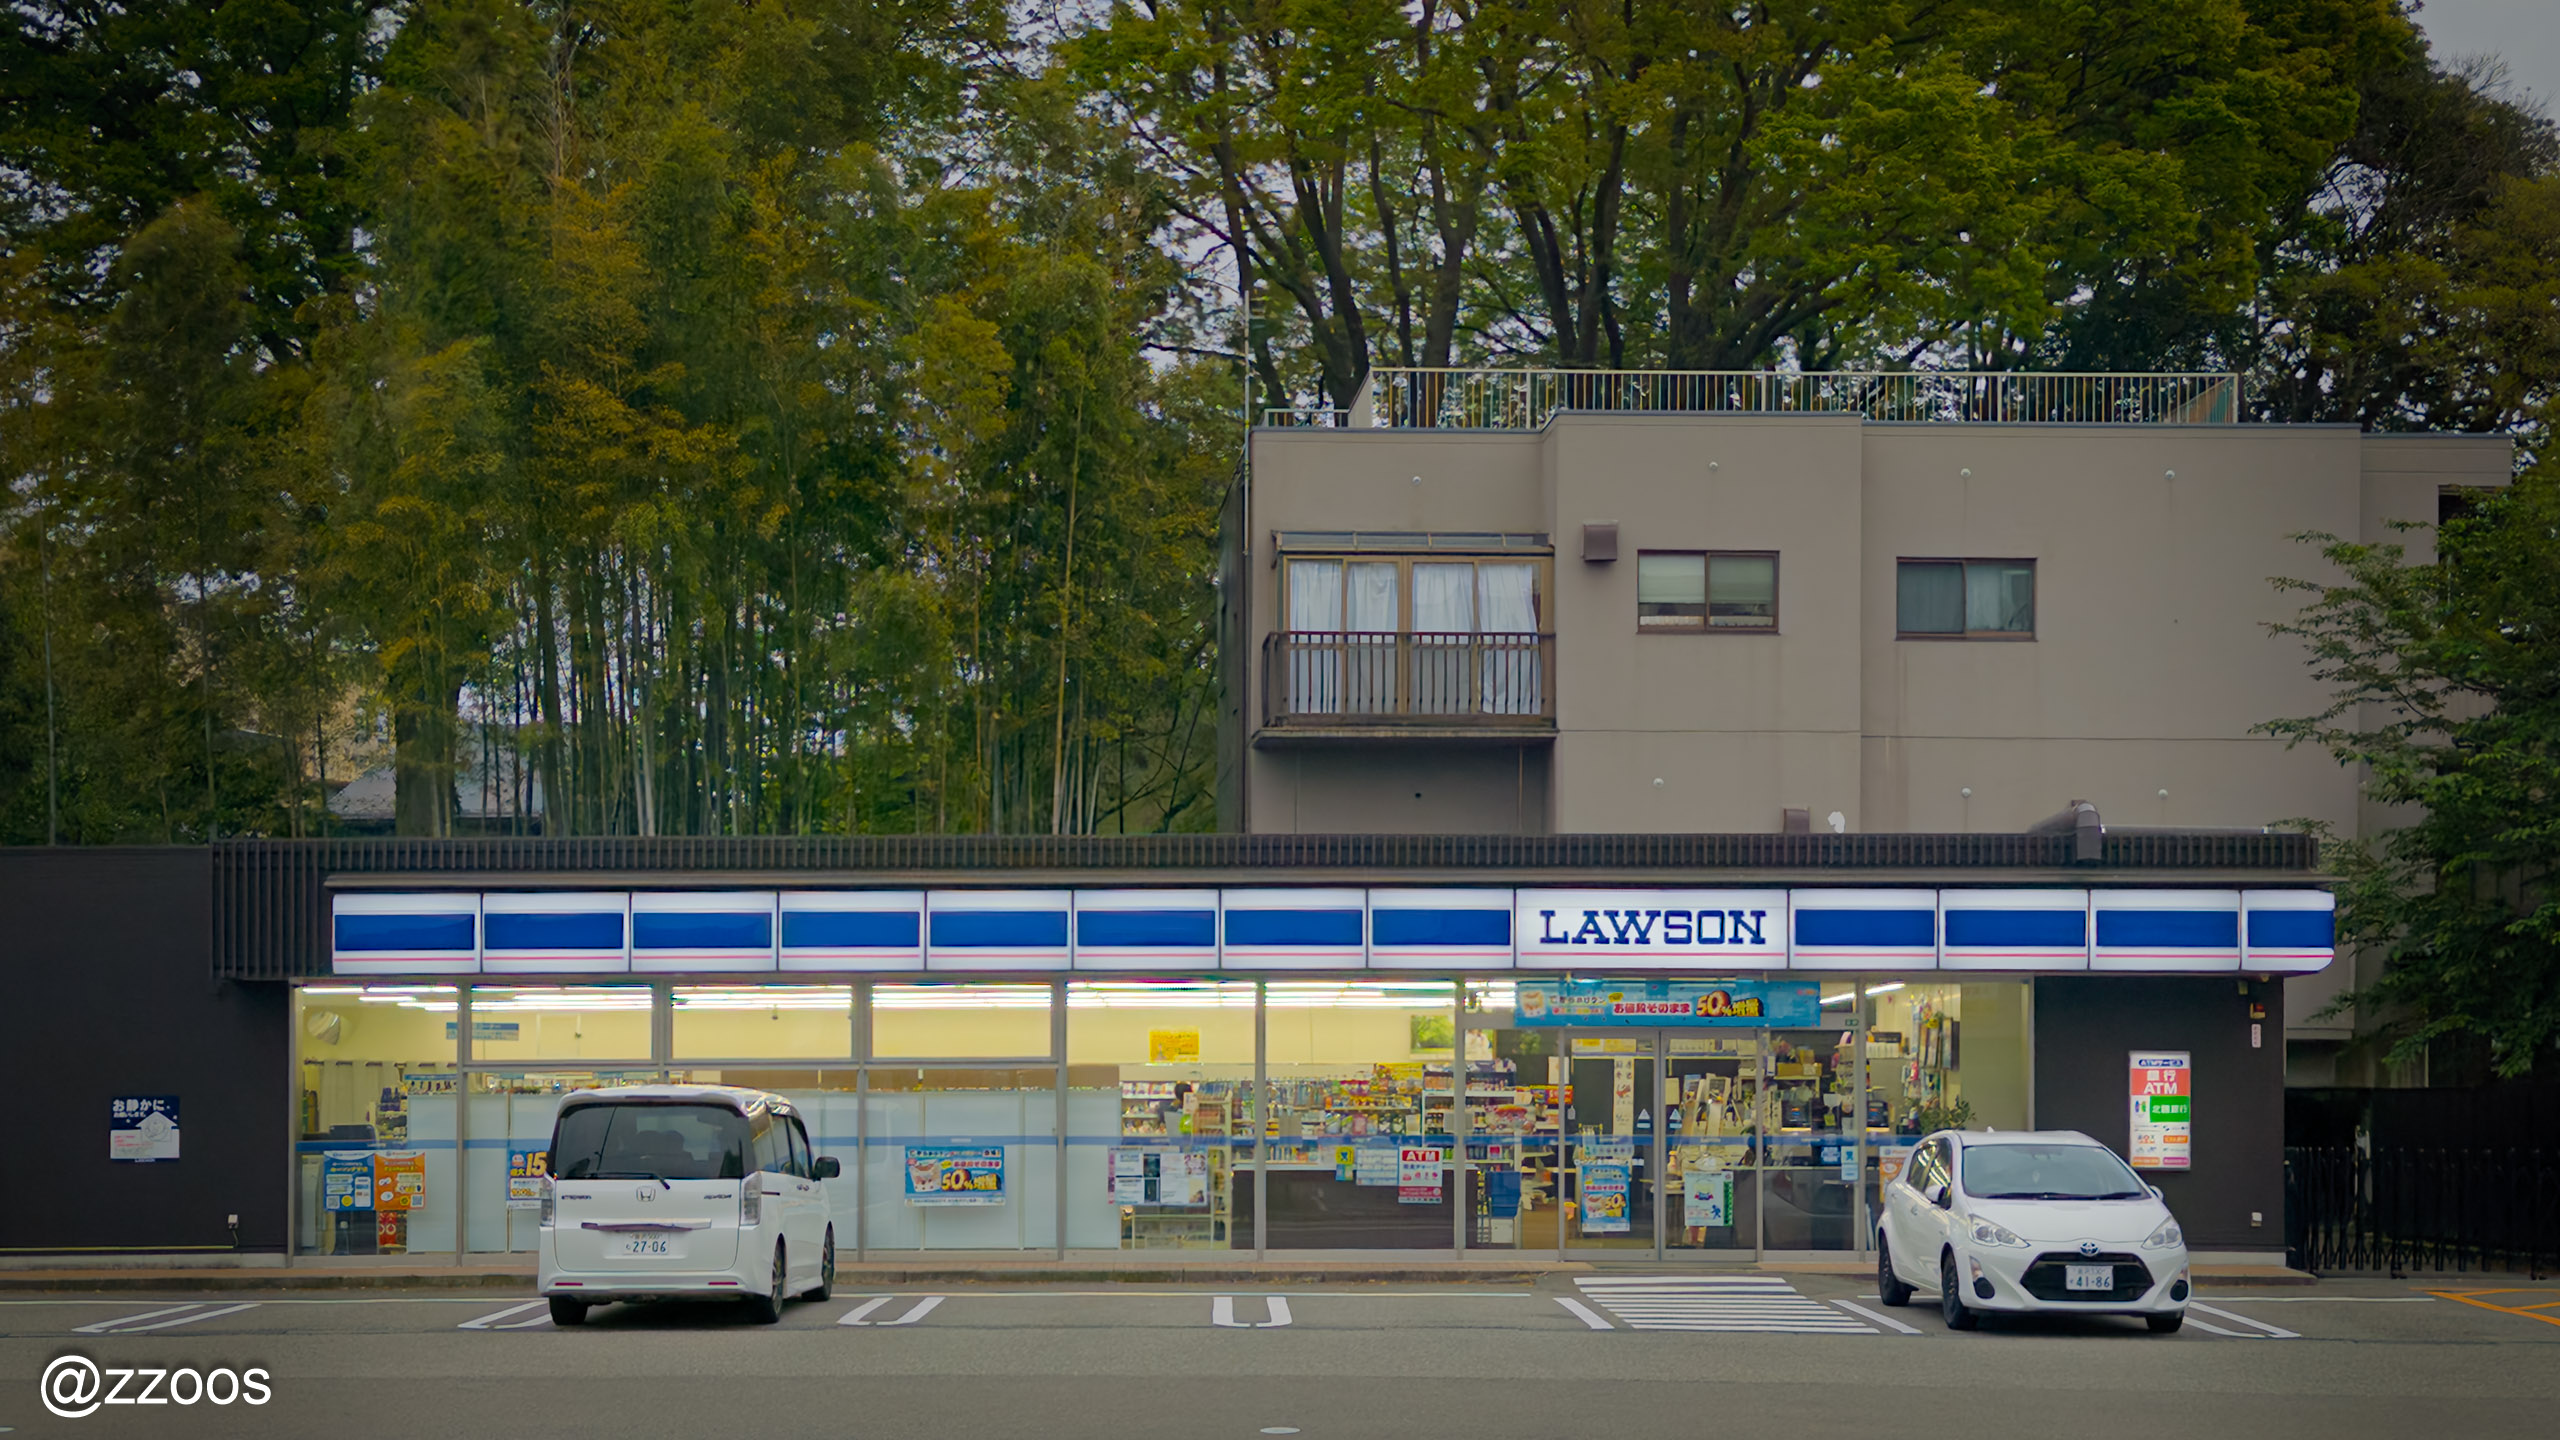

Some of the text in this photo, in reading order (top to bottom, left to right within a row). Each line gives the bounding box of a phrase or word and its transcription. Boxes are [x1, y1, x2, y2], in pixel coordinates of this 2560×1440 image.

[1540, 910, 1766, 945] LAWSON
[1613, 1003, 1690, 1014] お値段そのまま
[2143, 1082, 2178, 1095] ATM
[113, 1099, 165, 1111] お静かに
[1405, 1151, 1437, 1162] ATM
